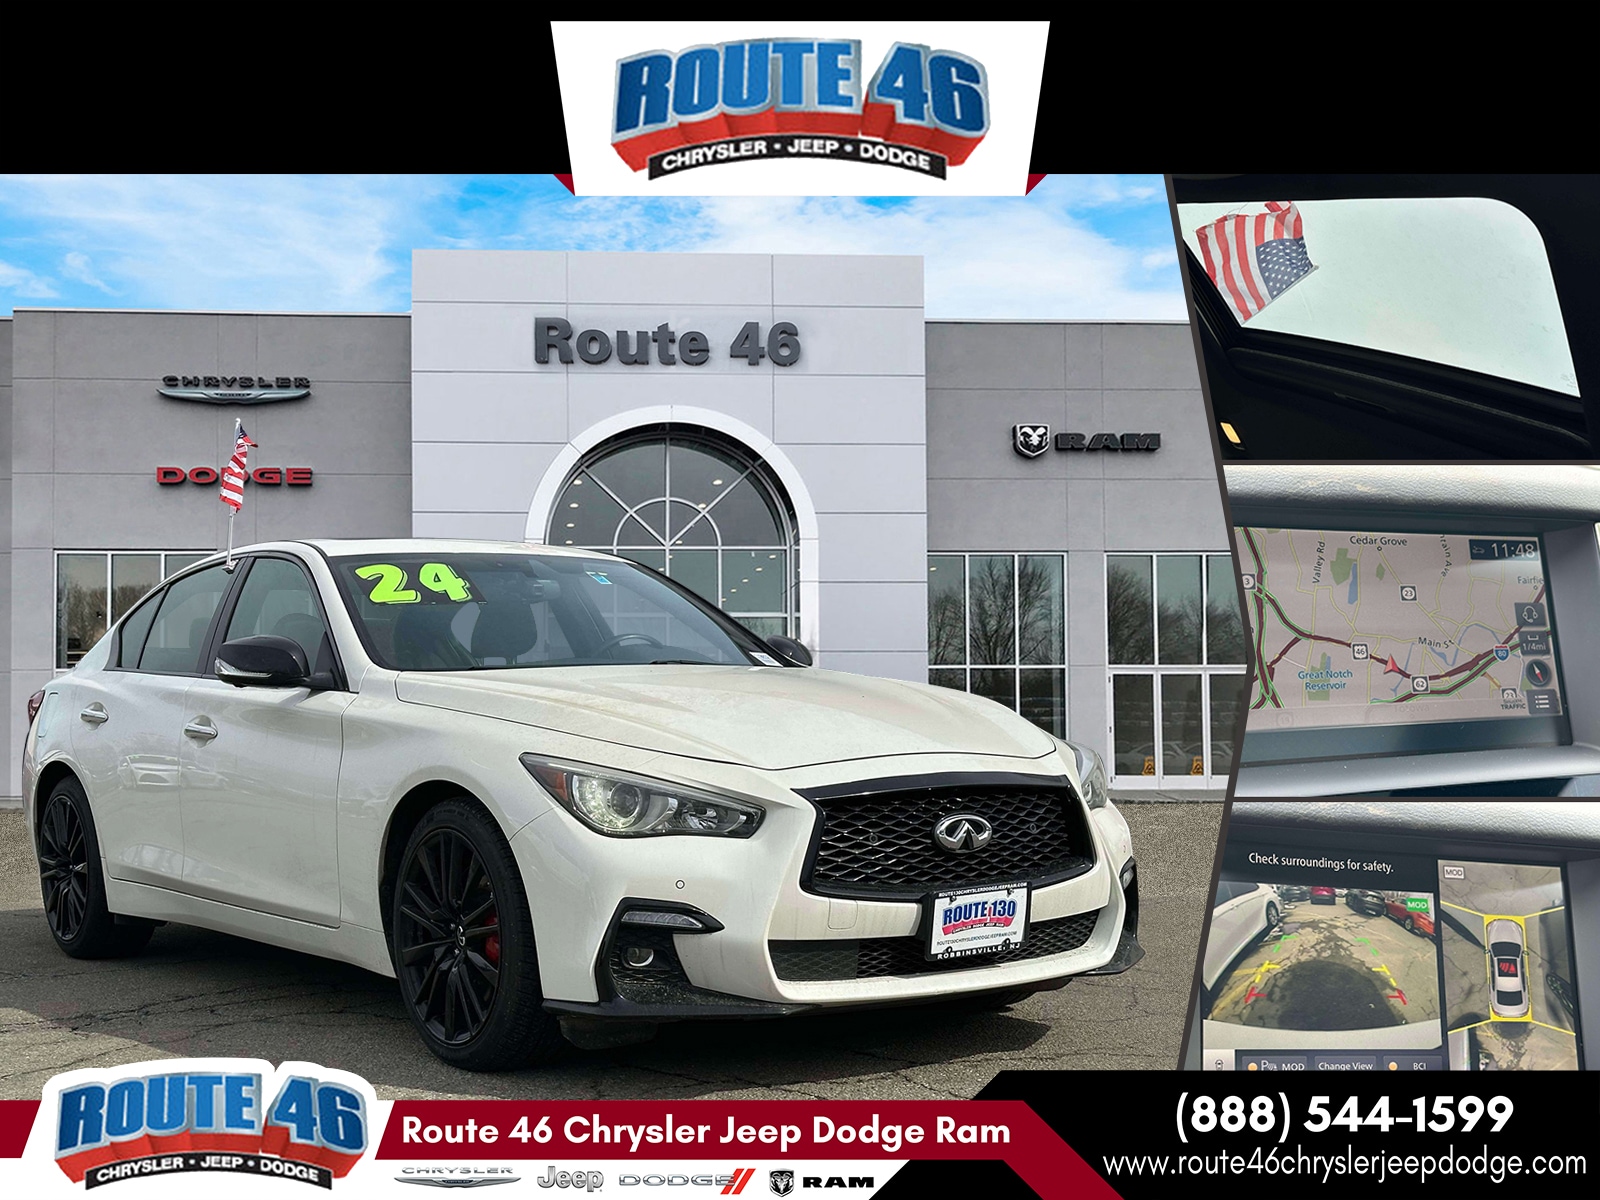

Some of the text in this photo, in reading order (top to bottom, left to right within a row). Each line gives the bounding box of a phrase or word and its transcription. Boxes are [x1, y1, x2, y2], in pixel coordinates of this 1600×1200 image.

[534, 317, 801, 366] Route 46
[162, 376, 312, 388] CHRYSLER
[1055, 433, 1161, 452] RAM
[1349, 536, 1408, 546] Cedar Grove
[1491, 543, 1535, 558] 11:48
[1312, 541, 1326, 584] Valley Rd
[1441, 560, 1452, 578] Ave
[355, 562, 473, 604] 24
[1245, 577, 1250, 586] 3
[1418, 637, 1441, 648] Main
[1522, 643, 1547, 651] 1/4mi
[1356, 649, 1366, 657] 46
[1298, 669, 1353, 680] Great Notch
[1305, 682, 1347, 692] Reservoir
[1248, 852, 1395, 874] Check surroundings for safety.
[1407, 901, 1427, 909] MOD
[943, 900, 1017, 926] ROUTE 130
[937, 945, 1006, 960] ROBBINSVILLE,
[1282, 1063, 1305, 1071] MOD
[1318, 1061, 1374, 1071] Change View
